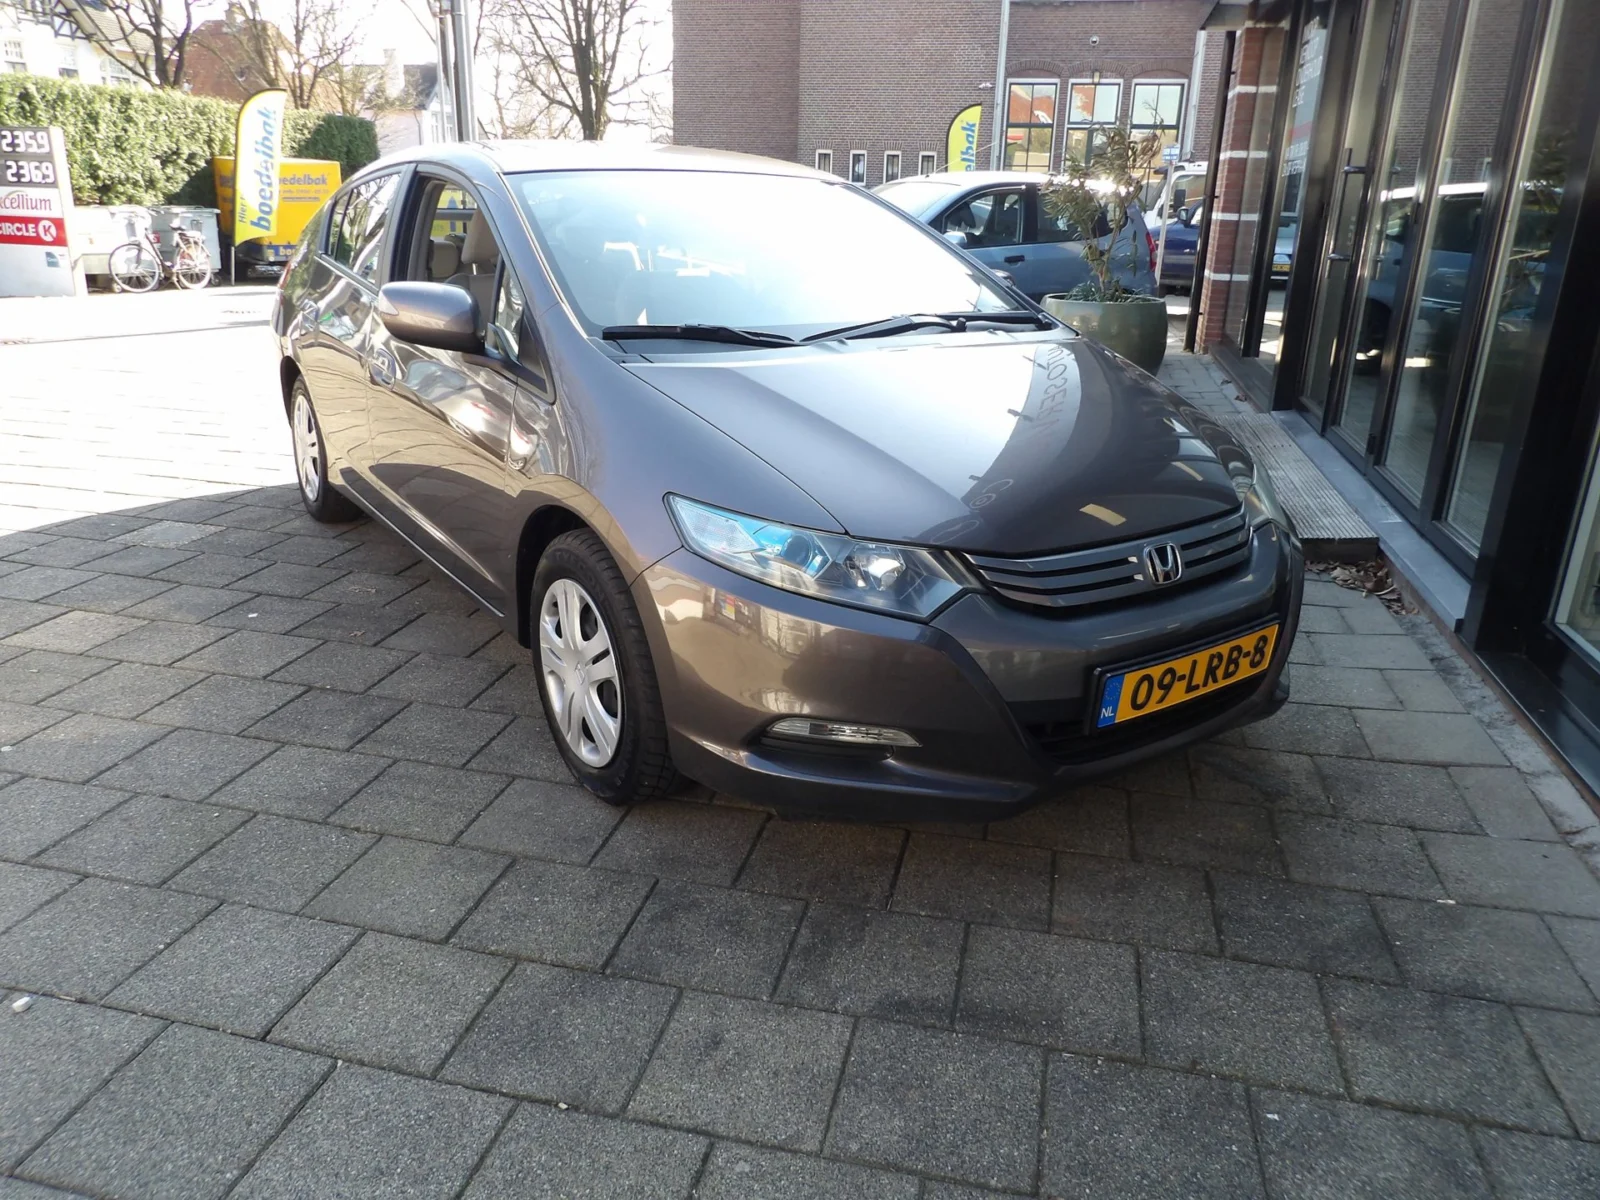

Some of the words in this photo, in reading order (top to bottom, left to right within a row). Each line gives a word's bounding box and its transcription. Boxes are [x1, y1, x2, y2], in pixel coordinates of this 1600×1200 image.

[250, 107, 277, 231] boedelbak
[279, 173, 328, 186] edelbak
[1129, 634, 1269, 712] 09-LRB-8
[1100, 705, 1115, 719] NL
